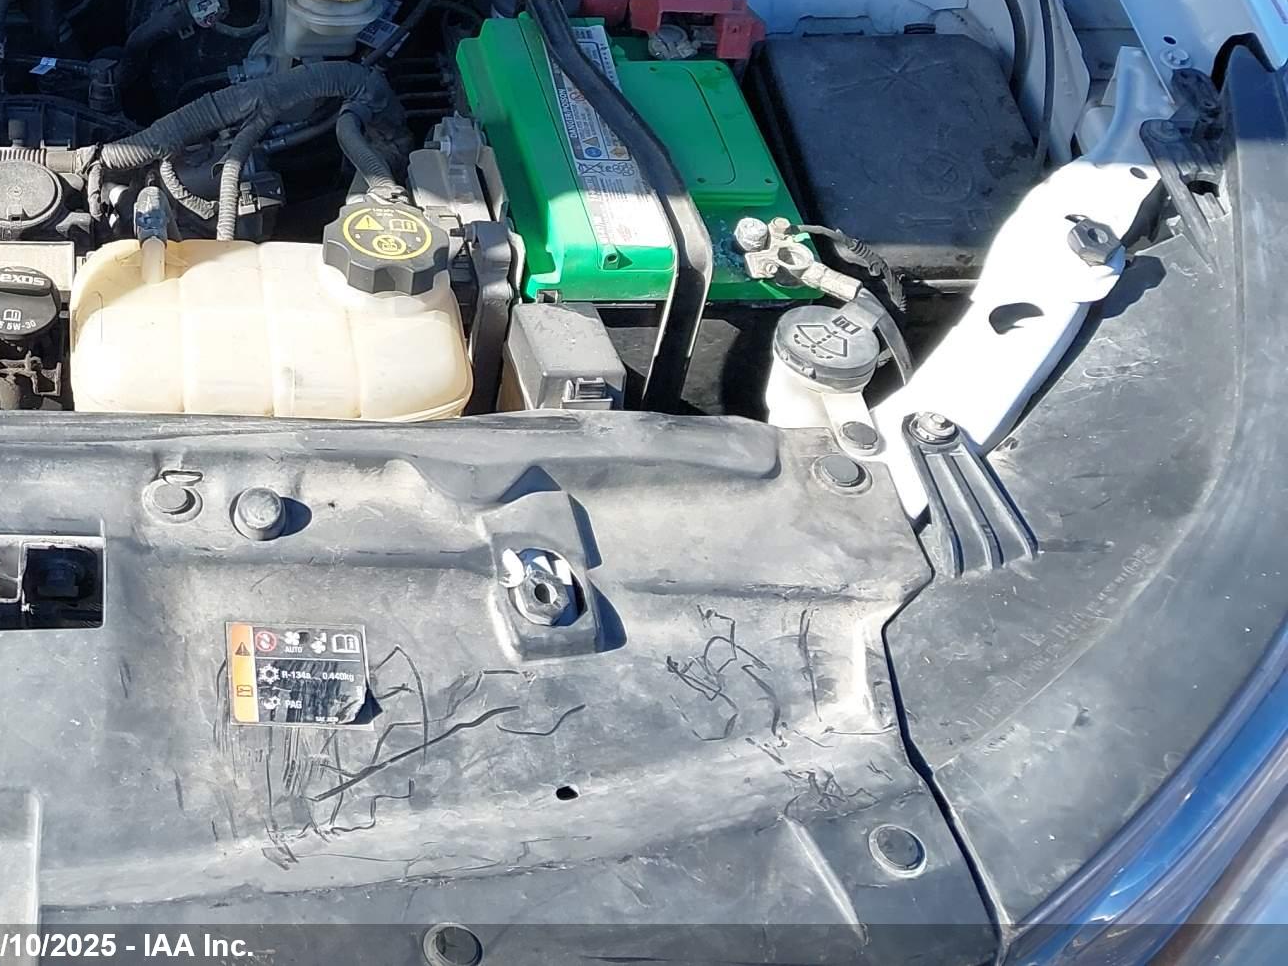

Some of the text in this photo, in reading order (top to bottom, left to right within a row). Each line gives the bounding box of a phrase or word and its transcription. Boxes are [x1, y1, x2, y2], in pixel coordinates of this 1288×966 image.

[558, 88, 579, 139] DANGER/POISON
[6, 320, 37, 331] 5W-30
[281, 670, 312, 680] R-134a
[285, 700, 303, 709] PAG
